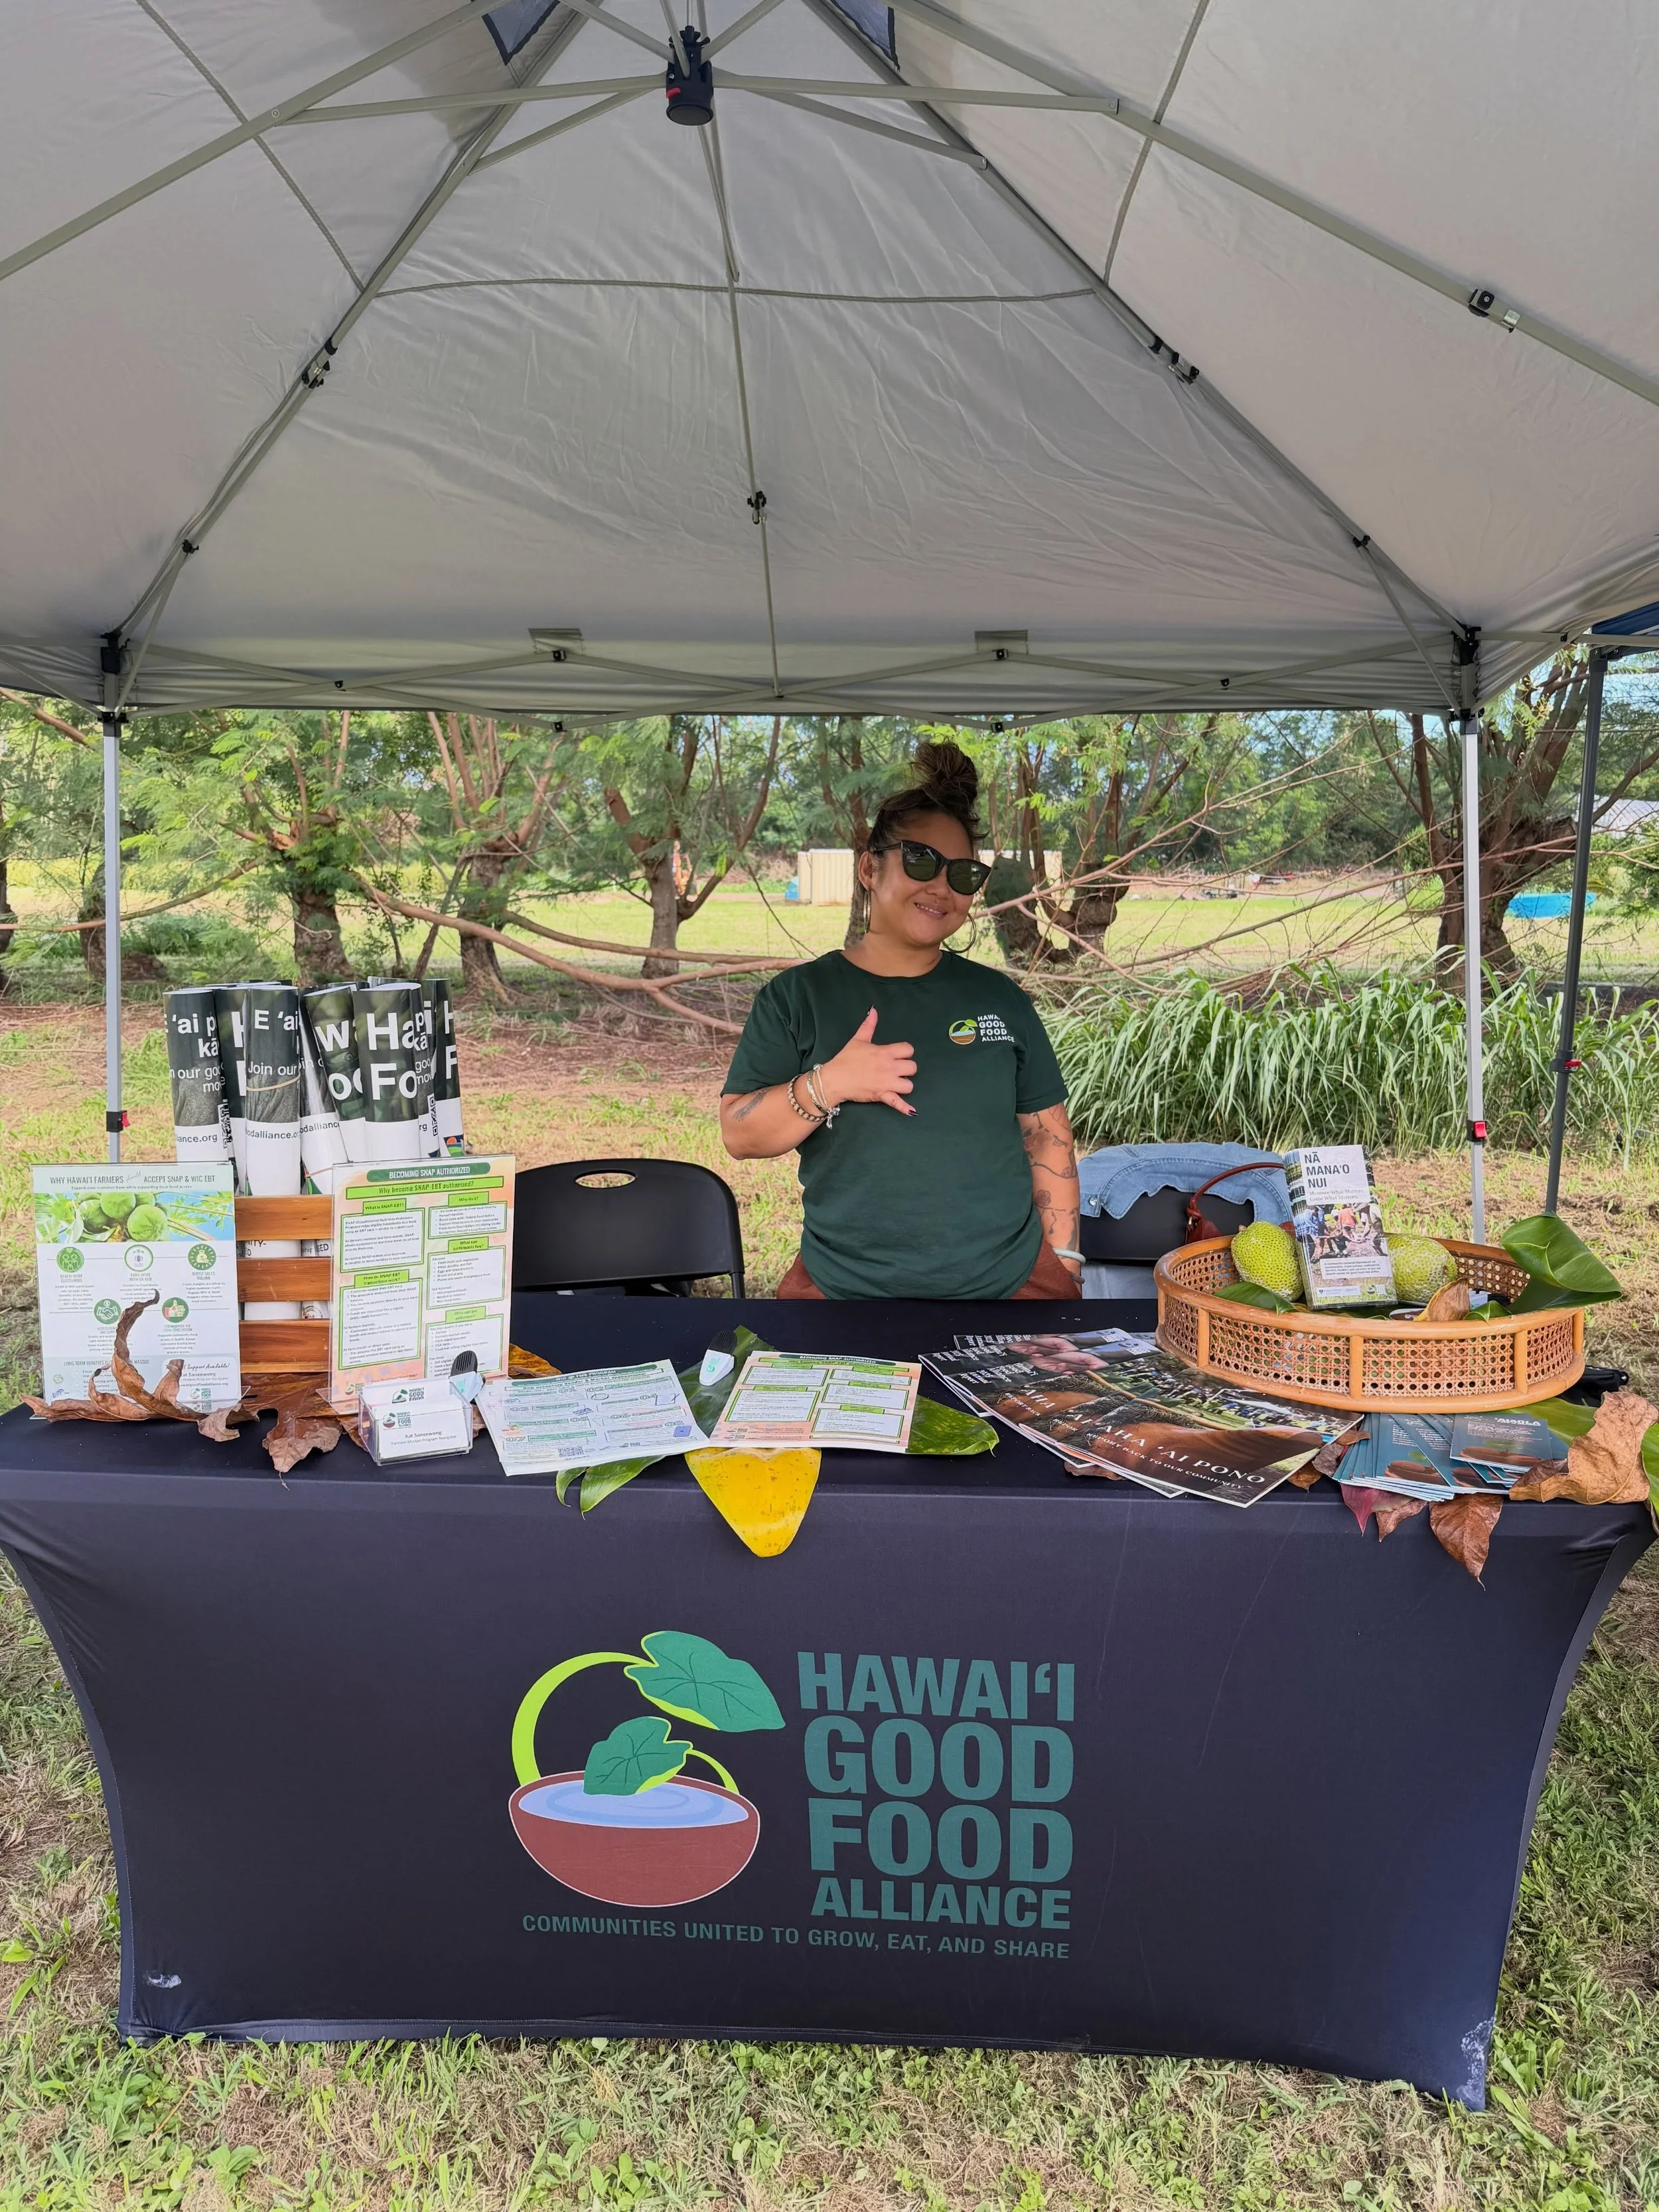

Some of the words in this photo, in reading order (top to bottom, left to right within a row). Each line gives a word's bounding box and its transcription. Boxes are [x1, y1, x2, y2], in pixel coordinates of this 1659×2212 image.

[177, 1067, 200, 1079] our
[248, 1061, 273, 1076] Join
[1305, 1151, 1320, 1164] NĀ
[389, 1169, 419, 1179] BECOMING
[419, 1169, 435, 1178] SNAP
[436, 1167, 470, 1177] AUTHORIZED
[392, 1185, 413, 1193] become
[414, 1183, 442, 1192] SNAP-EBT
[443, 1181, 474, 1189] authorized?
[1308, 1177, 1327, 1189] NUI
[987, 1367, 1012, 1382] Alliance
[1005, 1363, 1025, 1374] Good
[1086, 1432, 1122, 1449] REPORT
[1122, 1446, 1147, 1461] BACK
[1148, 1457, 1163, 1467] TO
[1163, 1462, 1185, 1475] OUR
[1185, 1469, 1244, 1489] COMMUNITY
[1194, 1459, 1265, 1485] PONO
[796, 1651, 1075, 1722] HAWAI‘I
[804, 1715, 1074, 1803] GOOD
[808, 1797, 1073, 1883] FOOD
[810, 1877, 1071, 1930] ALLIANCE
[522, 1914, 678, 1939] COMMUNITIES
[684, 1920, 765, 1945] UNITED
[770, 1926, 800, 1945] TO
[807, 1929, 880, 1953] GROW,
[887, 1933, 933, 1956] EAT,
[937, 1935, 987, 1955] AND
[993, 1939, 1070, 1960] SHARE
